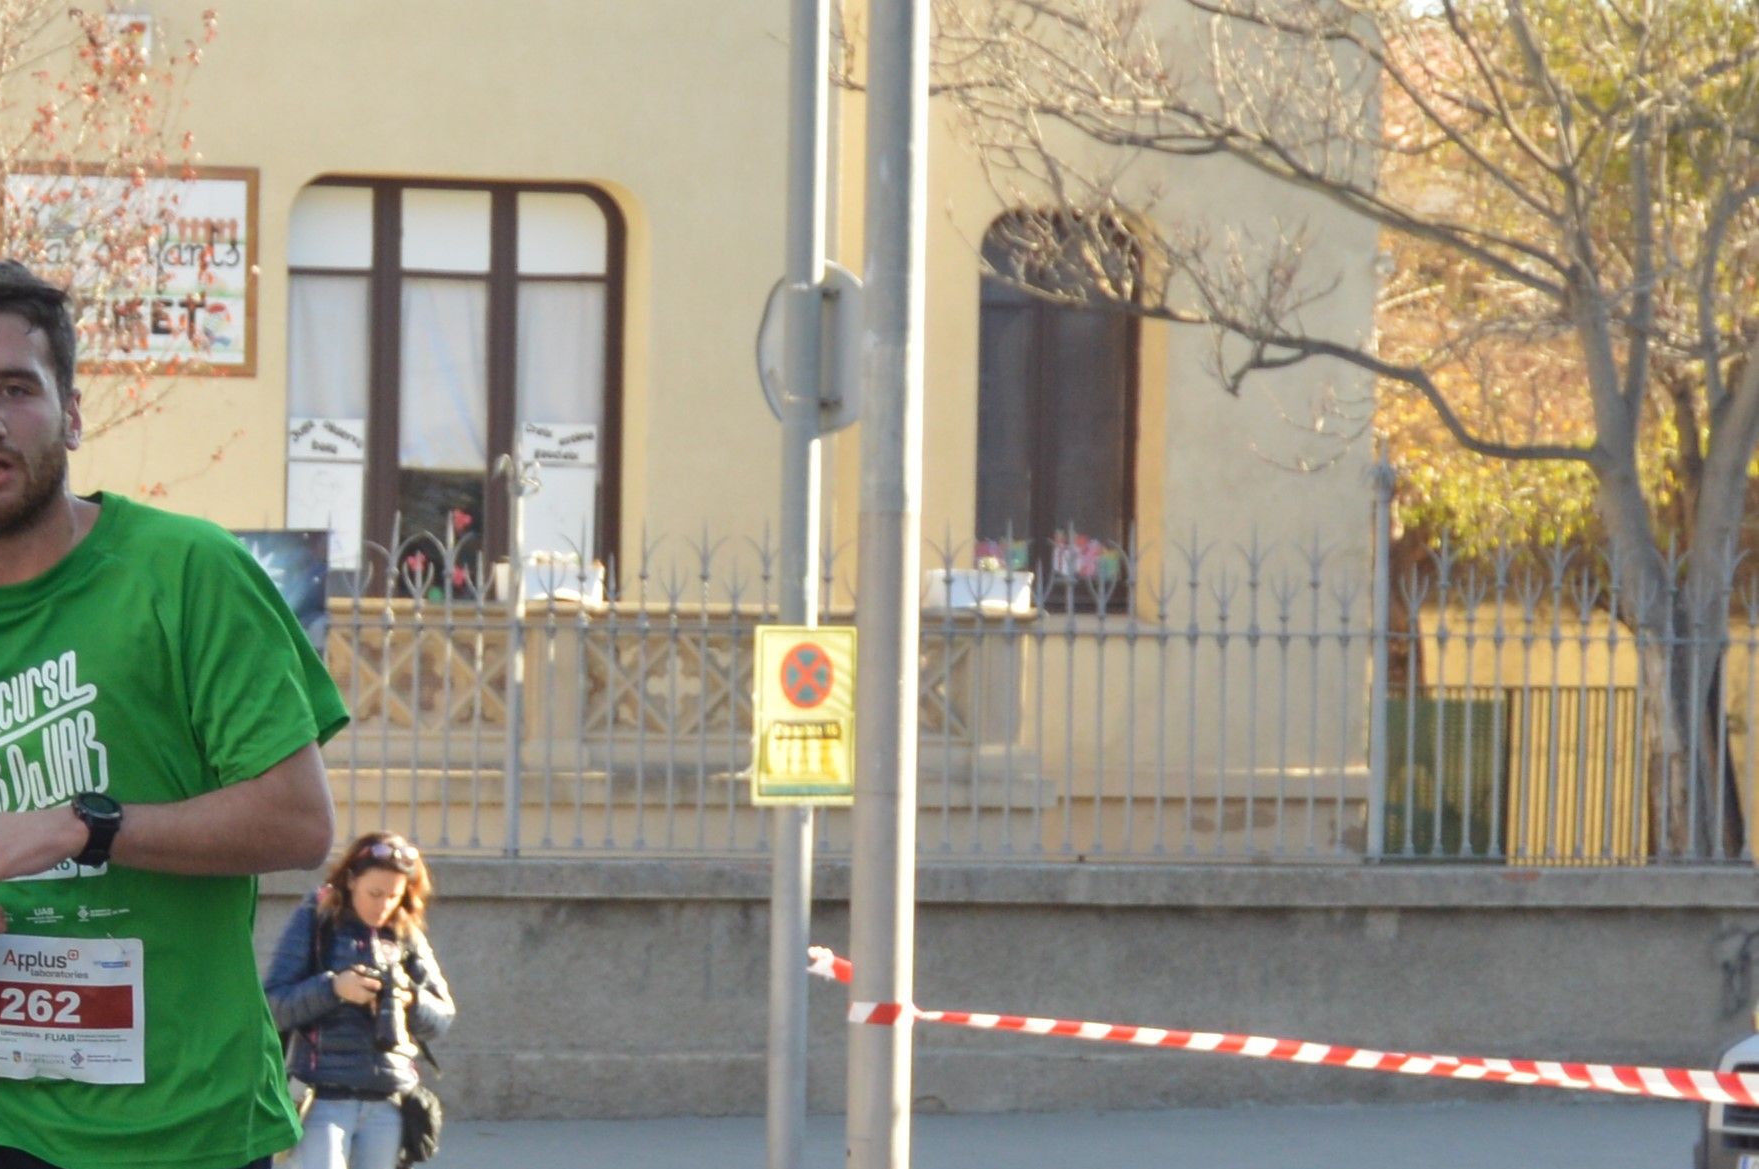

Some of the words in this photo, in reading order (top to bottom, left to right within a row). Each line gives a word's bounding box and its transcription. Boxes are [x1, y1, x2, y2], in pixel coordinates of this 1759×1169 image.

[30, 968, 90, 980] laboratories
[0, 987, 81, 1024] 262
[44, 1033, 75, 1042] FUAB
